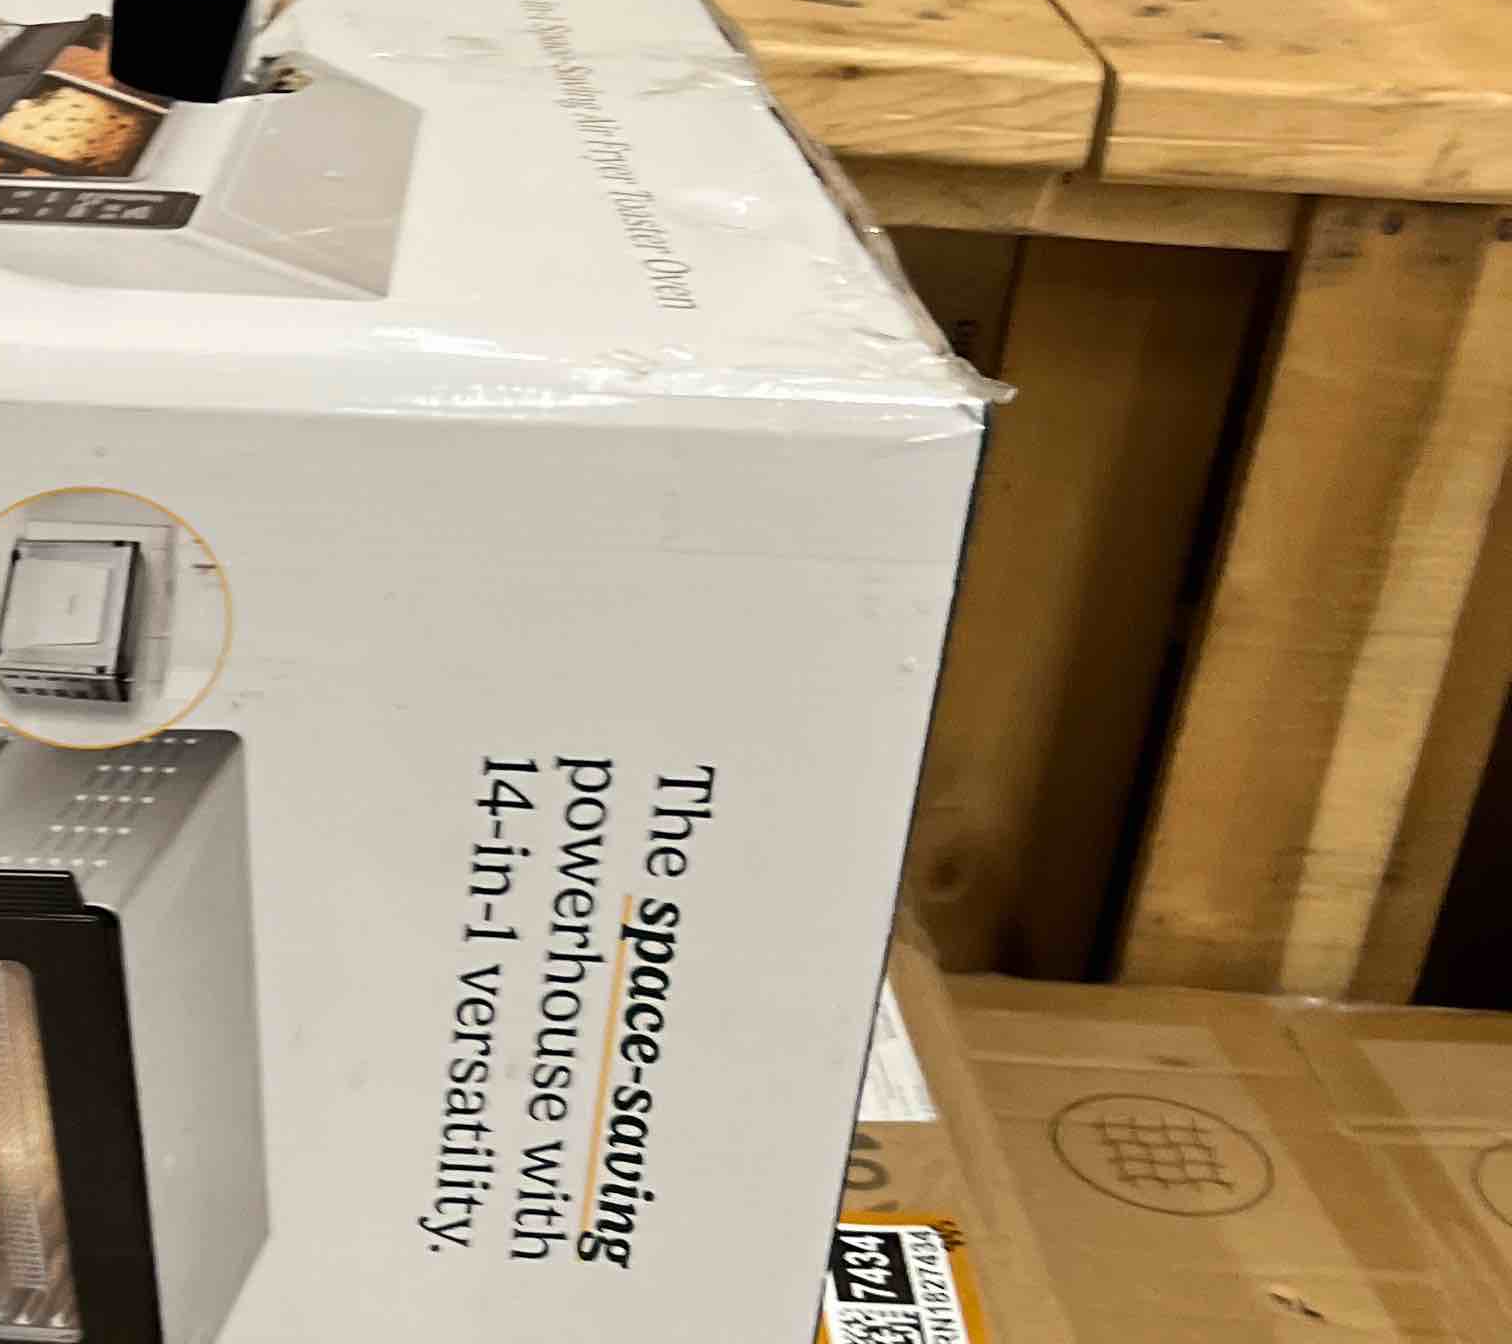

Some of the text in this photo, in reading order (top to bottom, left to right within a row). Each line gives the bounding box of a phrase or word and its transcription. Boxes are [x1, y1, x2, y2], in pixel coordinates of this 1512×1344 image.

[643, 258, 698, 310] Oven
[418, 755, 541, 1254] 14-in-1 versatility.
[509, 755, 614, 1261] powerhouse with
[577, 764, 716, 1269] The space-saving
[839, 1234, 899, 1300] 7434
